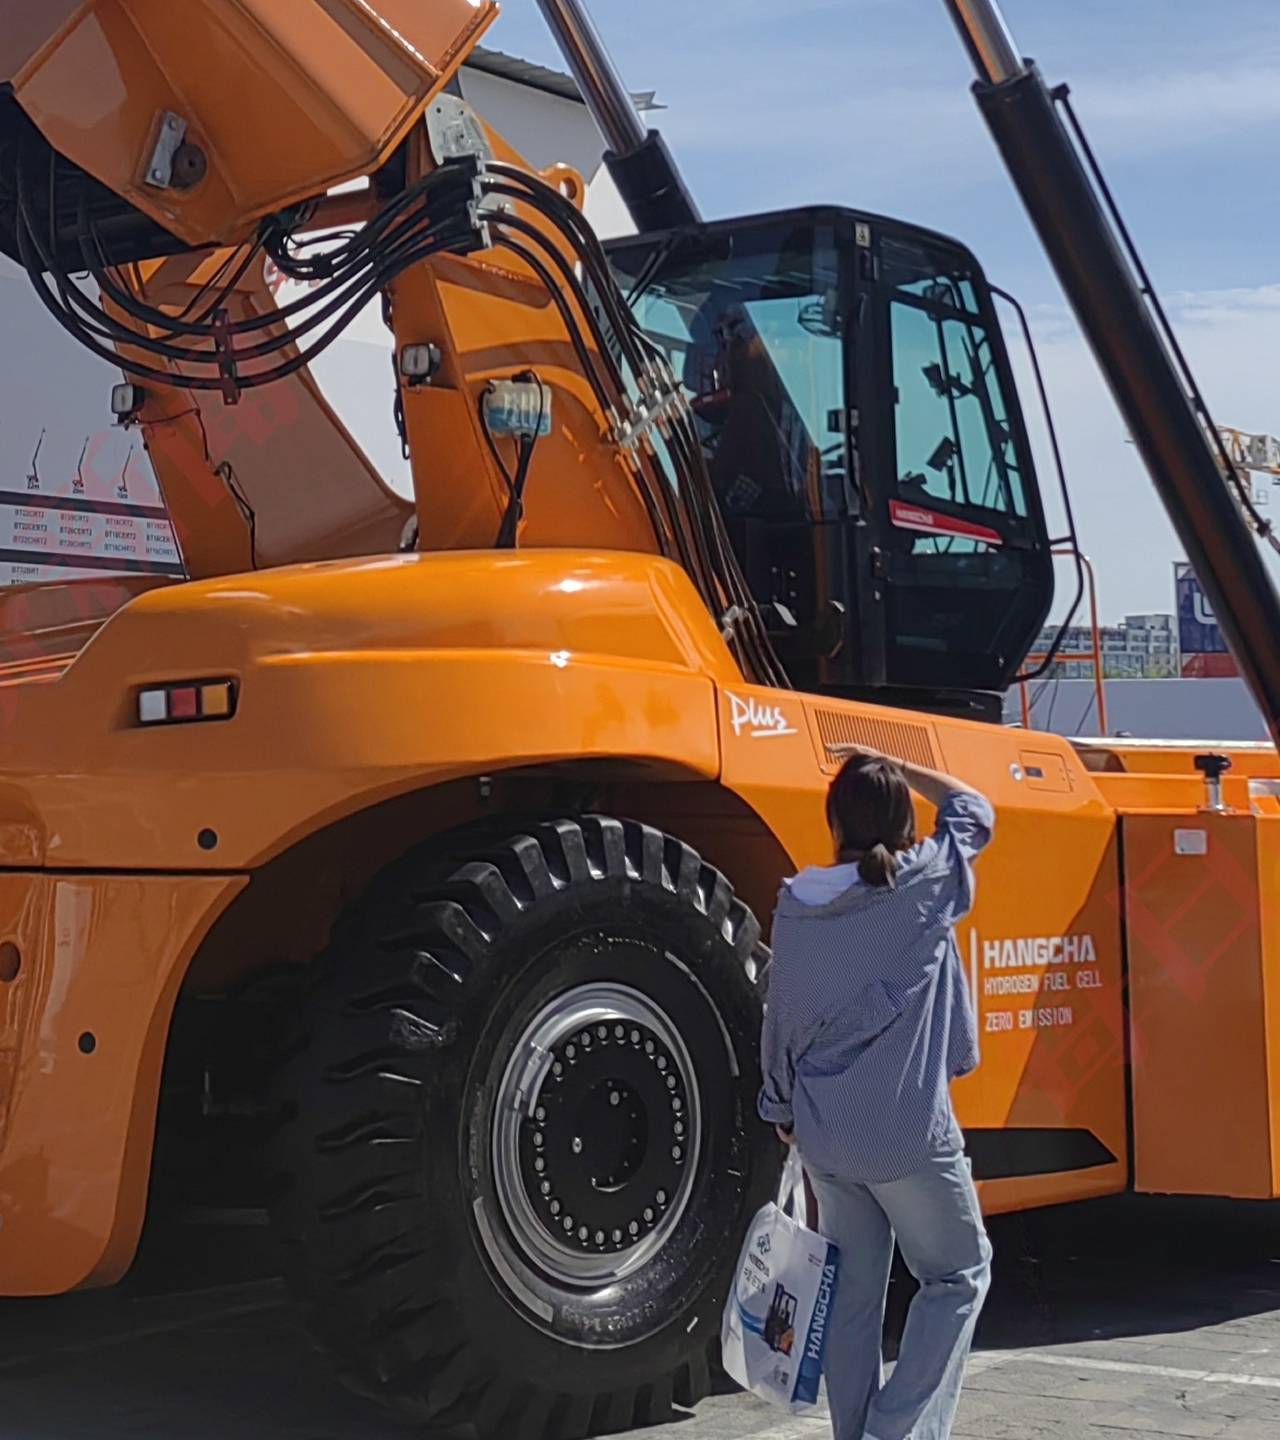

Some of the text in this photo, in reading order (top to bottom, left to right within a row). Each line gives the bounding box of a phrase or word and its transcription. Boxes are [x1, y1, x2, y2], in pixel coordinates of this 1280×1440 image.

[725, 690, 790, 736] Plus
[983, 934, 1096, 968] HANGCHA
[984, 970, 1102, 996] HYDROGEN FUEL CELL
[985, 1007, 1072, 1032] ZERO EMISSION
[807, 1264, 836, 1359] HANGCHA
